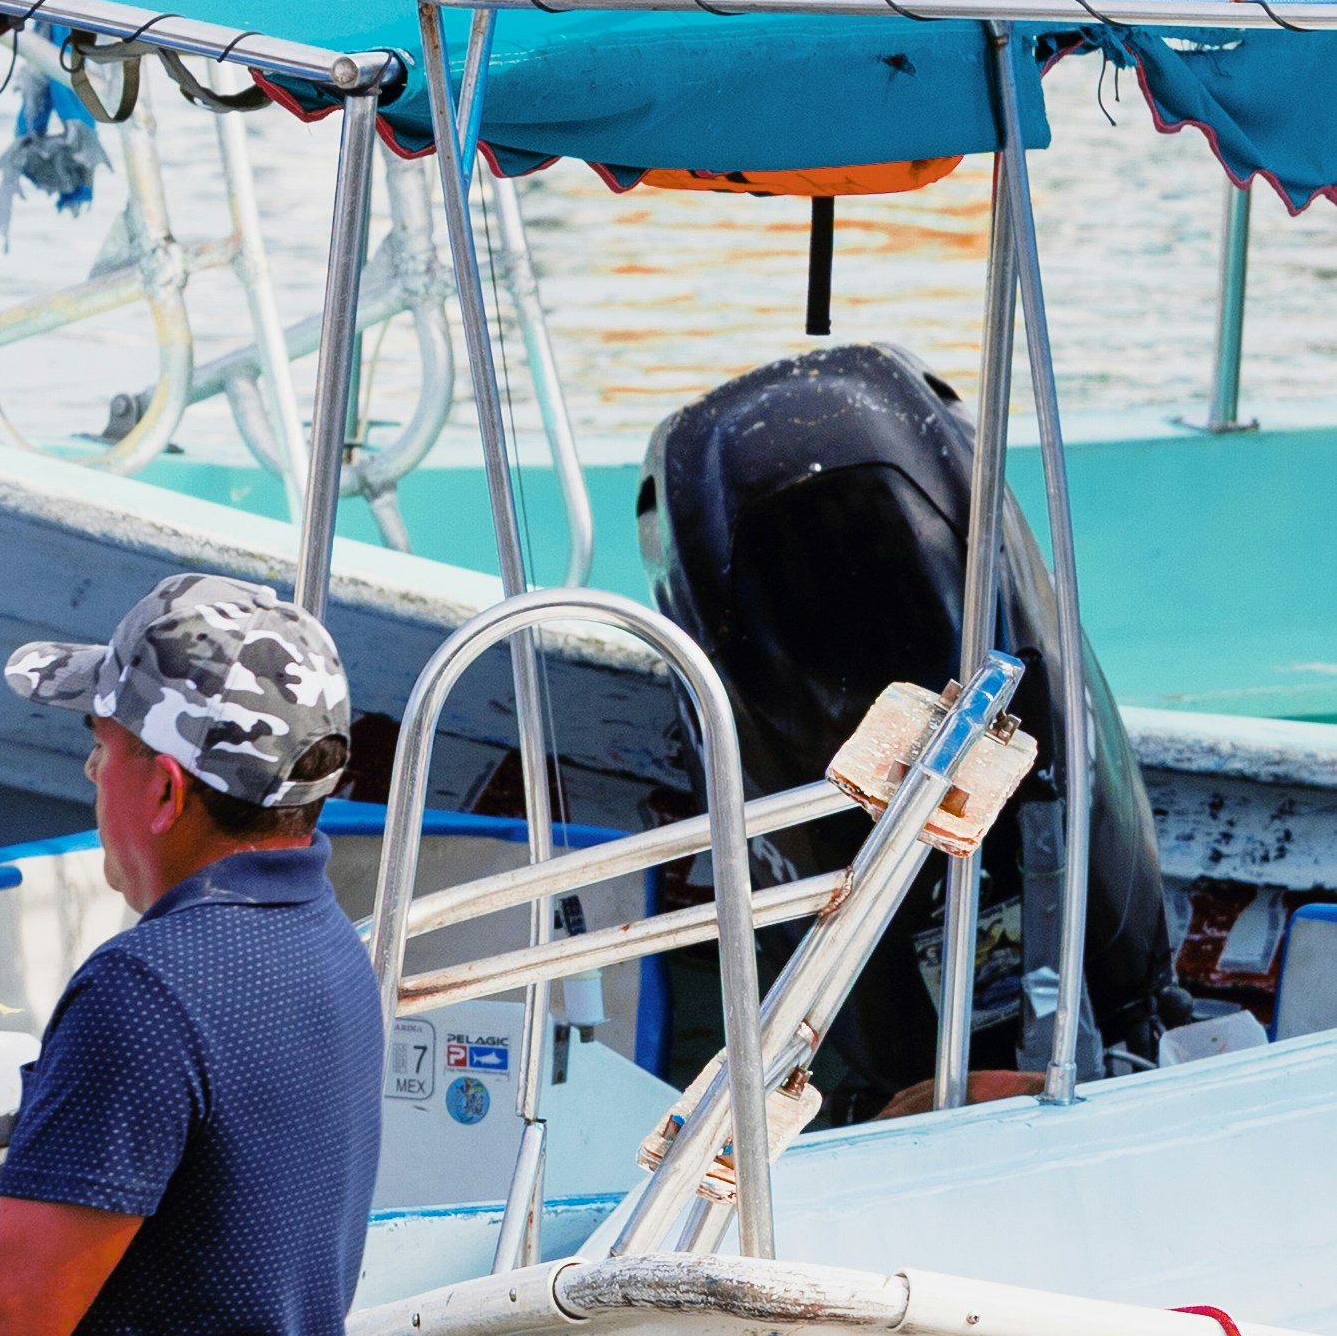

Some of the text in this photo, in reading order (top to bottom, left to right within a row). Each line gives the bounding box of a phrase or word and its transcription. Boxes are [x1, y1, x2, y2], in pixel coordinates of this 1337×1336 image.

[447, 1033, 509, 1047] PELAGIC
[413, 1045, 427, 1074] 7
[396, 1078, 426, 1094] MEX
